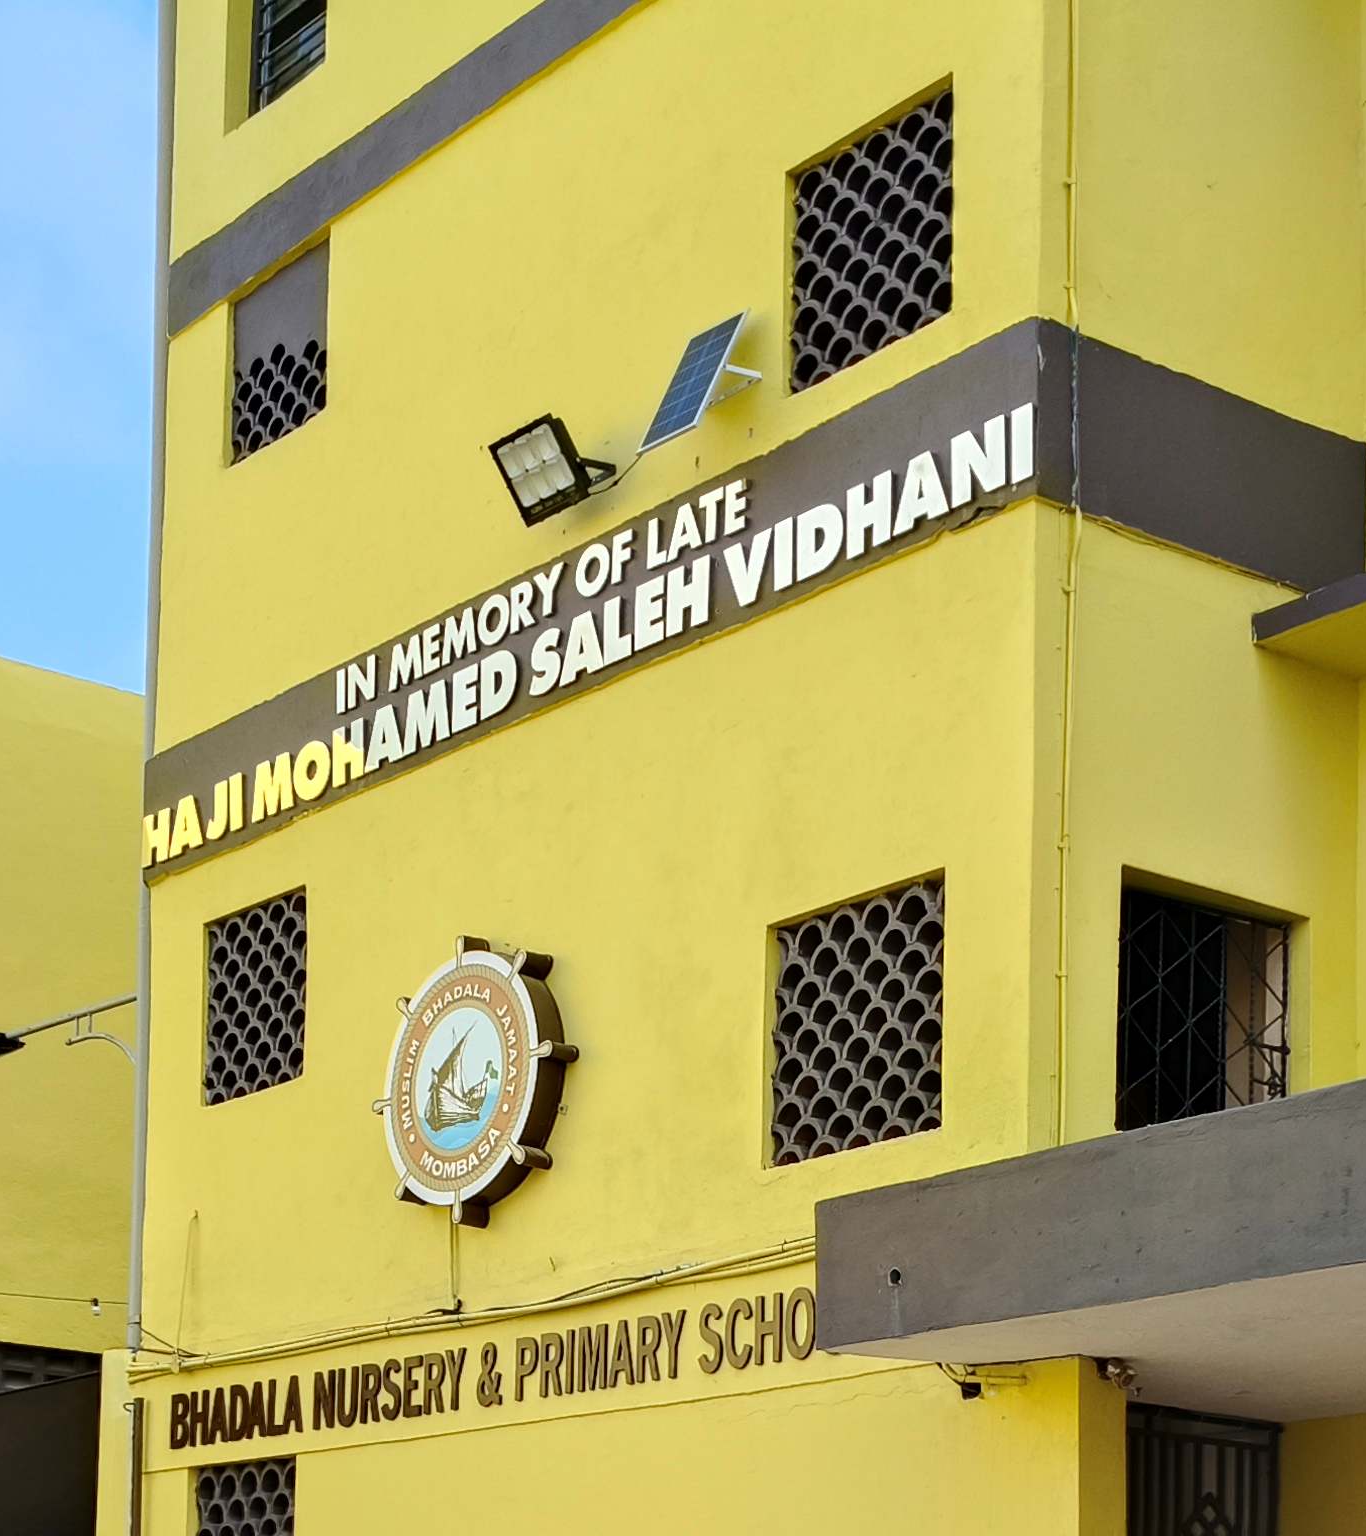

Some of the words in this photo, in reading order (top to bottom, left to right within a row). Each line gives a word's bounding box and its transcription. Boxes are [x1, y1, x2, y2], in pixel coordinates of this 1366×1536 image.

[142, 772, 244, 868] HAJI
[251, 649, 518, 823] MOHAMED
[529, 554, 712, 696] SALEH
[723, 402, 1035, 608] VIDHANI
[336, 654, 377, 714] IN
[388, 562, 565, 693] MEMORY
[575, 528, 634, 598] OF
[646, 478, 748, 570] LATE
[400, 1039, 420, 1130] MUSLIM
[421, 983, 492, 1028] BHADALA
[495, 1003, 518, 1097] JAMAAT
[419, 1127, 502, 1178] MOMBASA
[170, 1374, 304, 1449] BHADALA
[312, 1347, 468, 1431] NURSERY
[476, 1342, 504, 1408] &
[515, 1309, 688, 1402] PRIMARY
